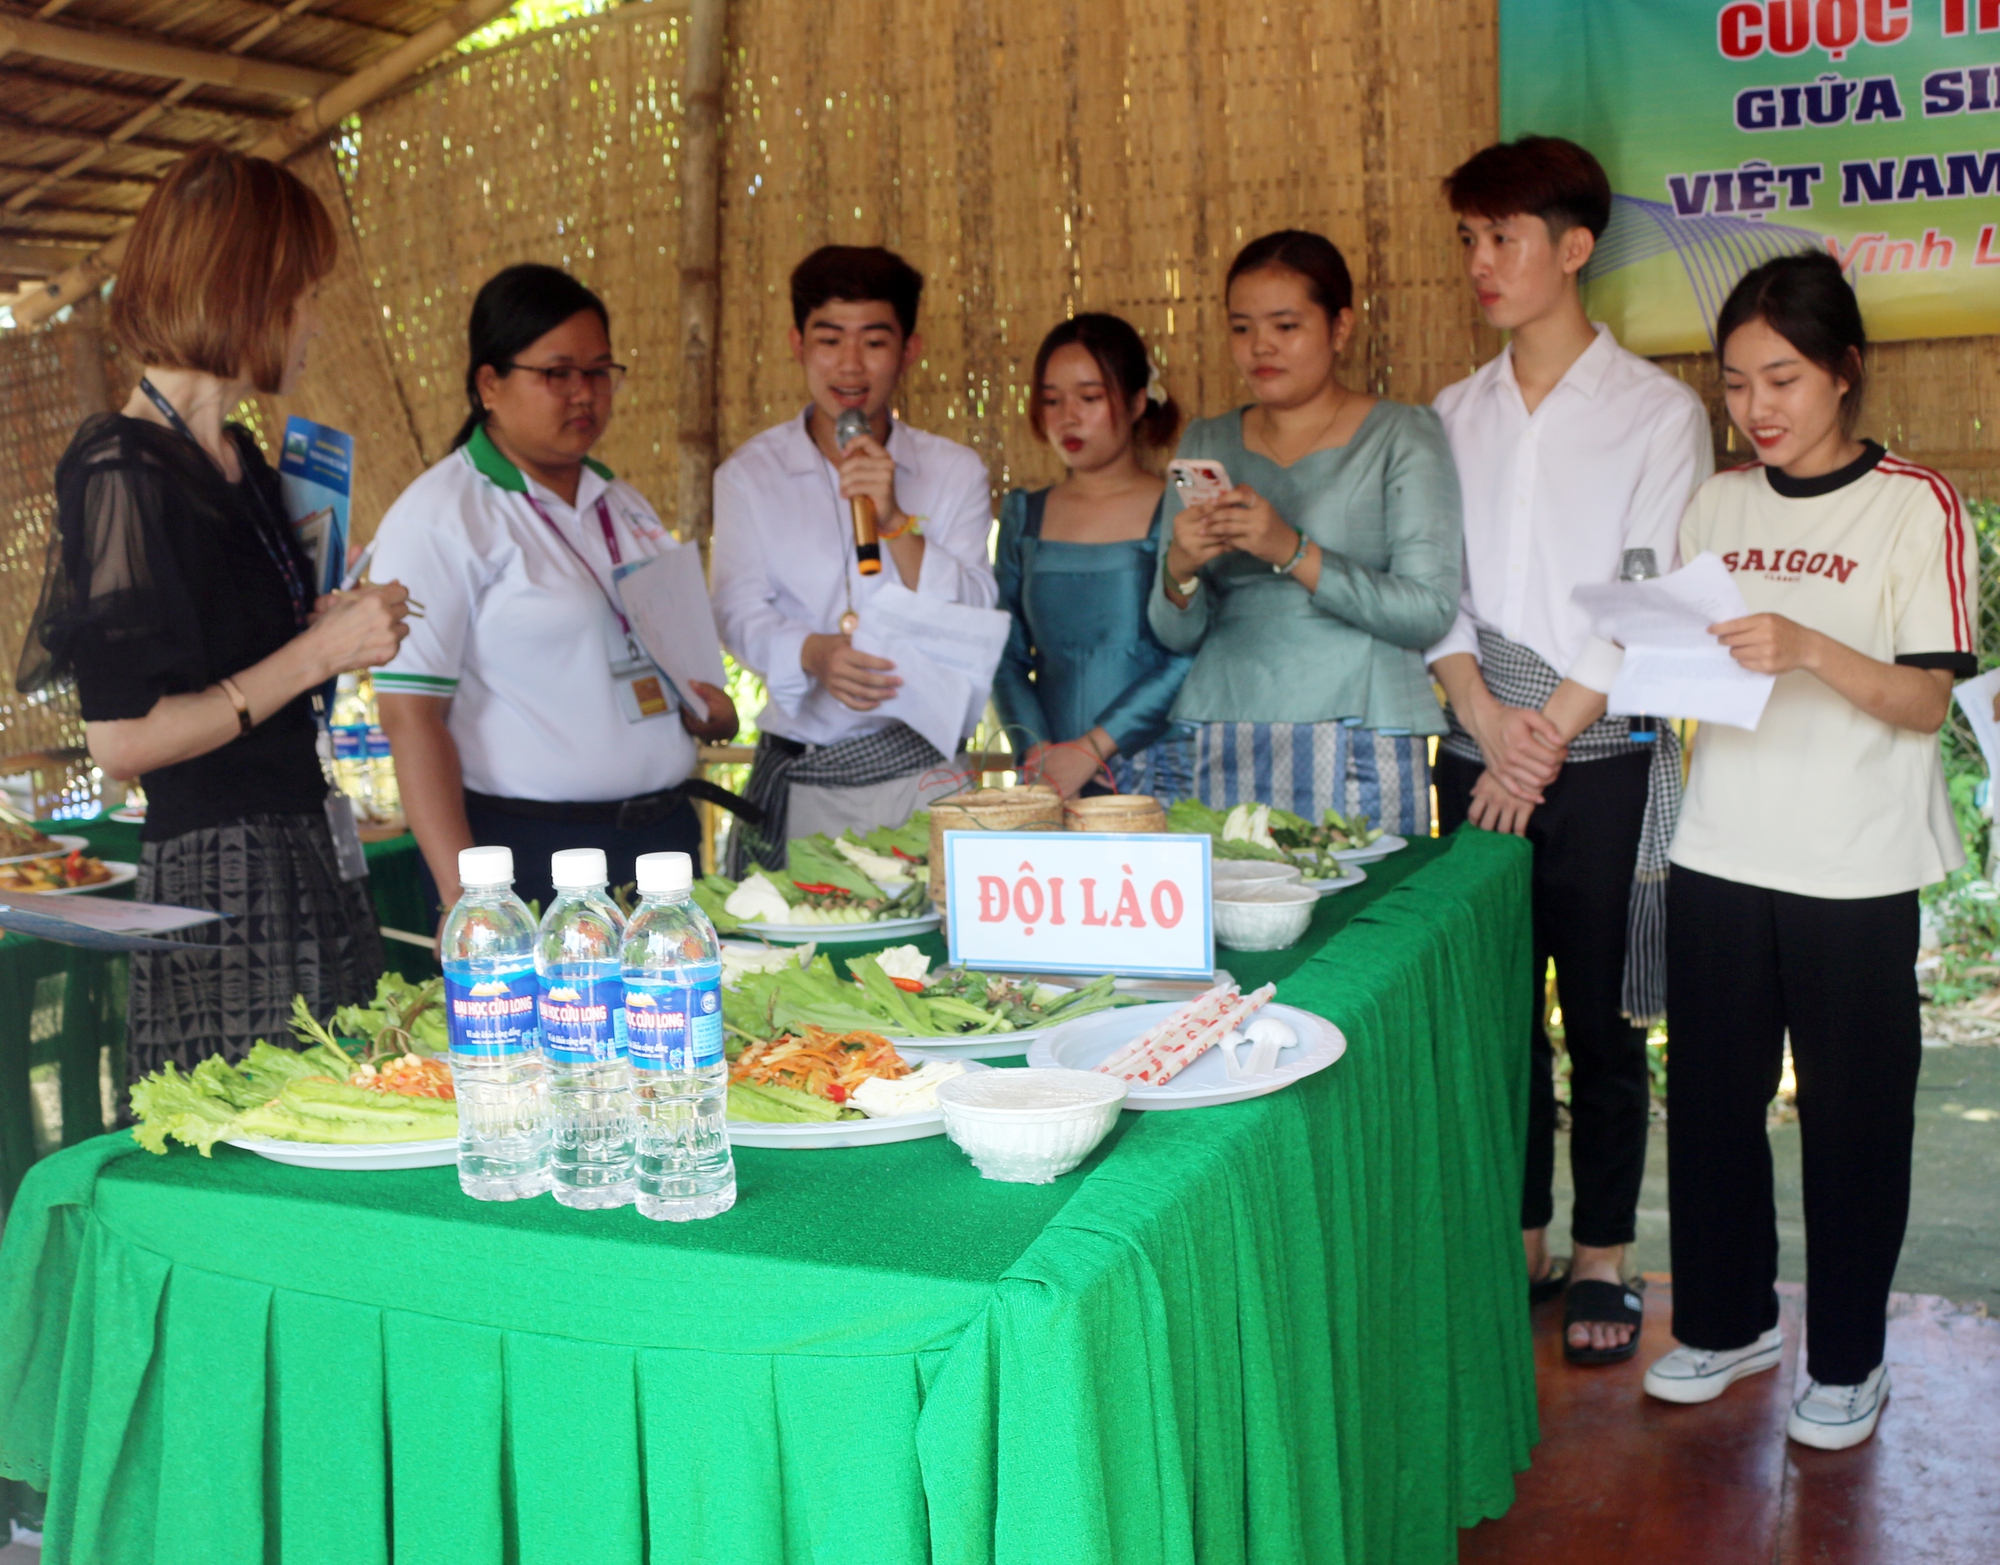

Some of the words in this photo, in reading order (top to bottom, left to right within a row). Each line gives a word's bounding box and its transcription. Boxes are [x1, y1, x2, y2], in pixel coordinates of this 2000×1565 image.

[1736, 74, 1903, 130] GIỮA
[1923, 67, 2000, 115] SI
[1668, 161, 1822, 219] VIỆT
[1824, 228, 1955, 275] Vĩnh
[1722, 548, 1858, 585] SAIGON
[978, 860, 1066, 937] ĐỘI
[1079, 863, 1184, 929] LÀO
[468, 1000, 487, 1019] HỌC
[509, 995, 533, 1014] LONG
[580, 1004, 608, 1023] LONG
[656, 1012, 685, 1029] LONG
